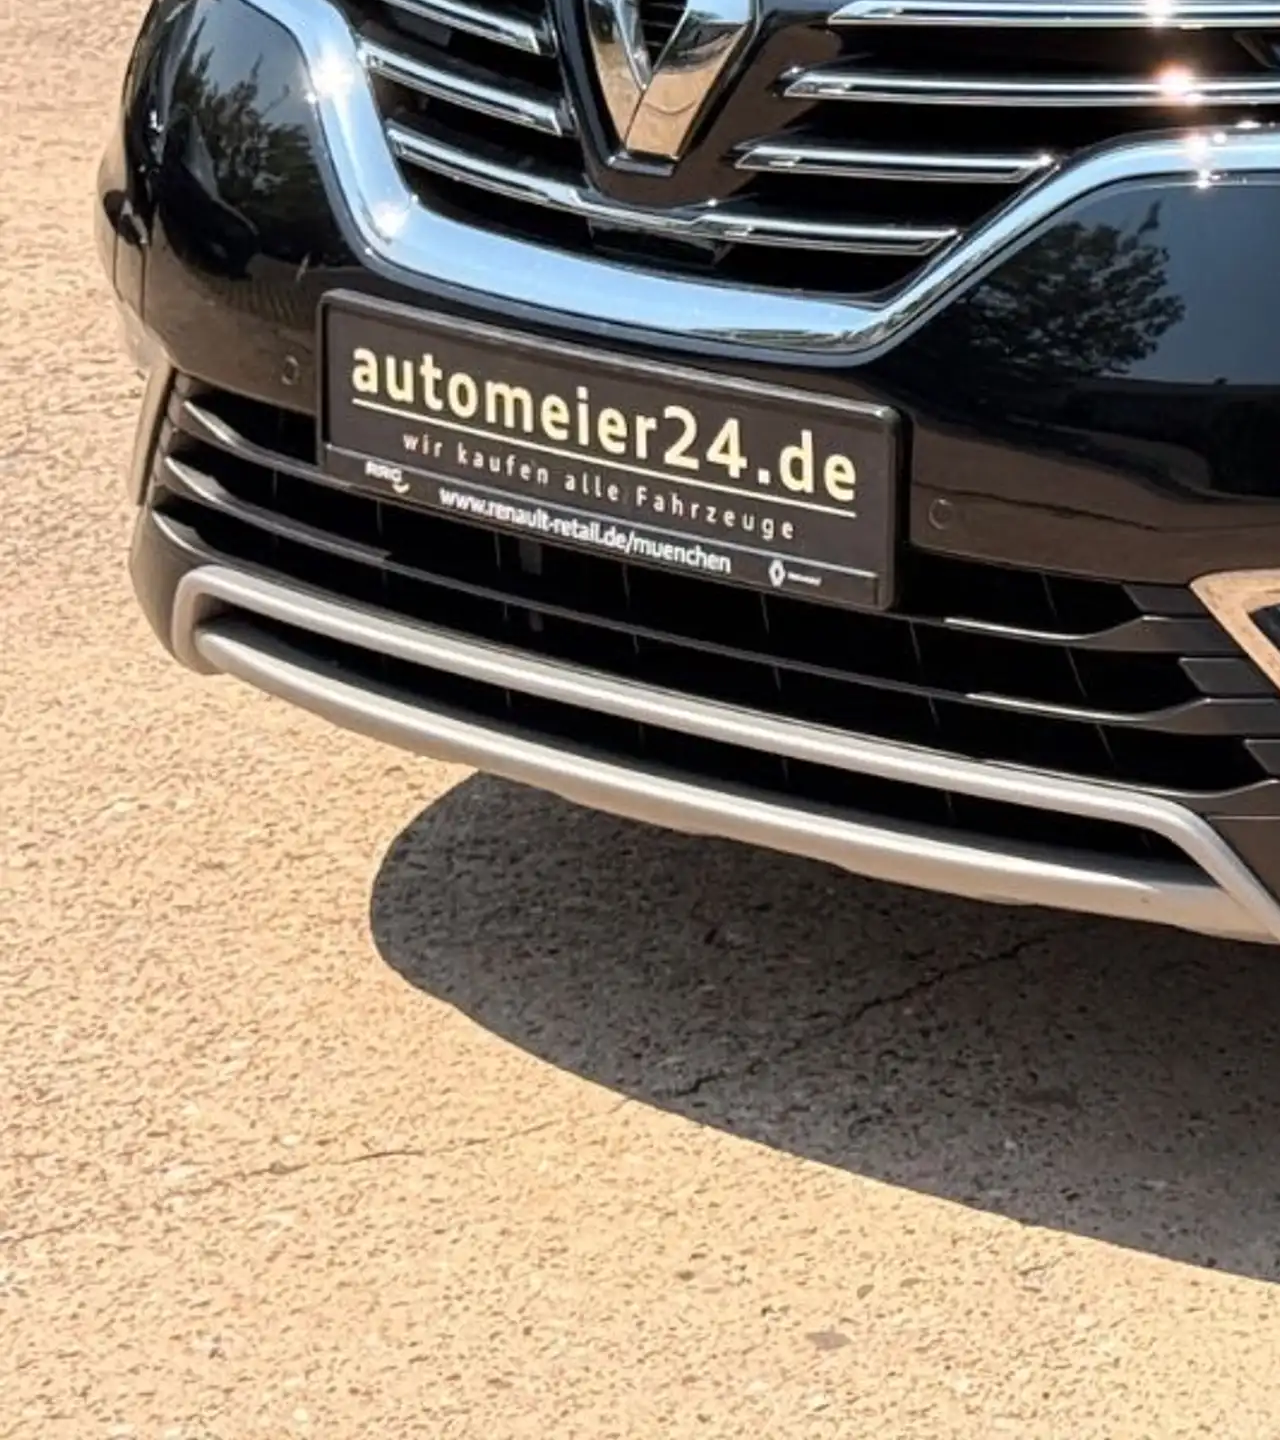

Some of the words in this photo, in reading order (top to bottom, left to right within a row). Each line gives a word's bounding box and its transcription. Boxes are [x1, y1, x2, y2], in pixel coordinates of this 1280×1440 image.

[351, 346, 857, 502] automeier24.de
[403, 432, 444, 458] wir
[457, 442, 550, 486] kaufen
[564, 472, 620, 503] alle
[636, 485, 795, 541] Fahrzeuge
[438, 486, 732, 574] www.renault-retail.de/muenchen
